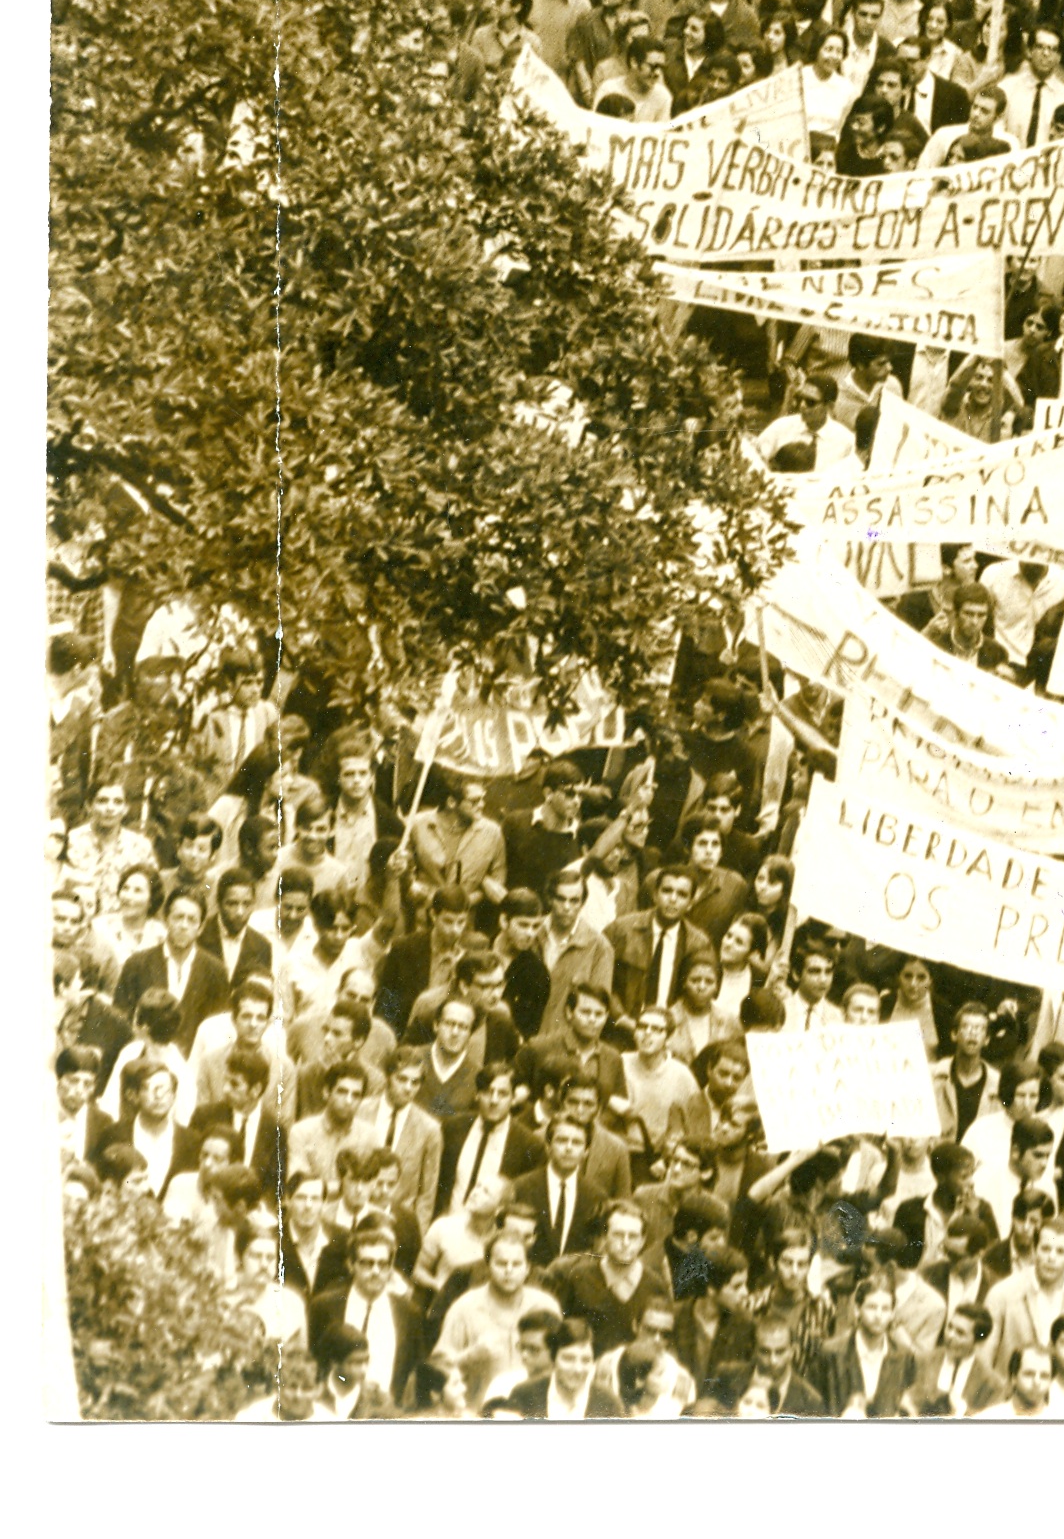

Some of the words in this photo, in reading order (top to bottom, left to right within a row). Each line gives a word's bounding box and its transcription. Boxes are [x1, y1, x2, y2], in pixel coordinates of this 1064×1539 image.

[609, 133, 691, 193] MAIS
[802, 167, 883, 222] PARA
[851, 207, 923, 252] COM
[822, 483, 1051, 530] ASSASSINA
[838, 799, 1048, 899] LIBERDADE
[883, 872, 943, 932] OS
